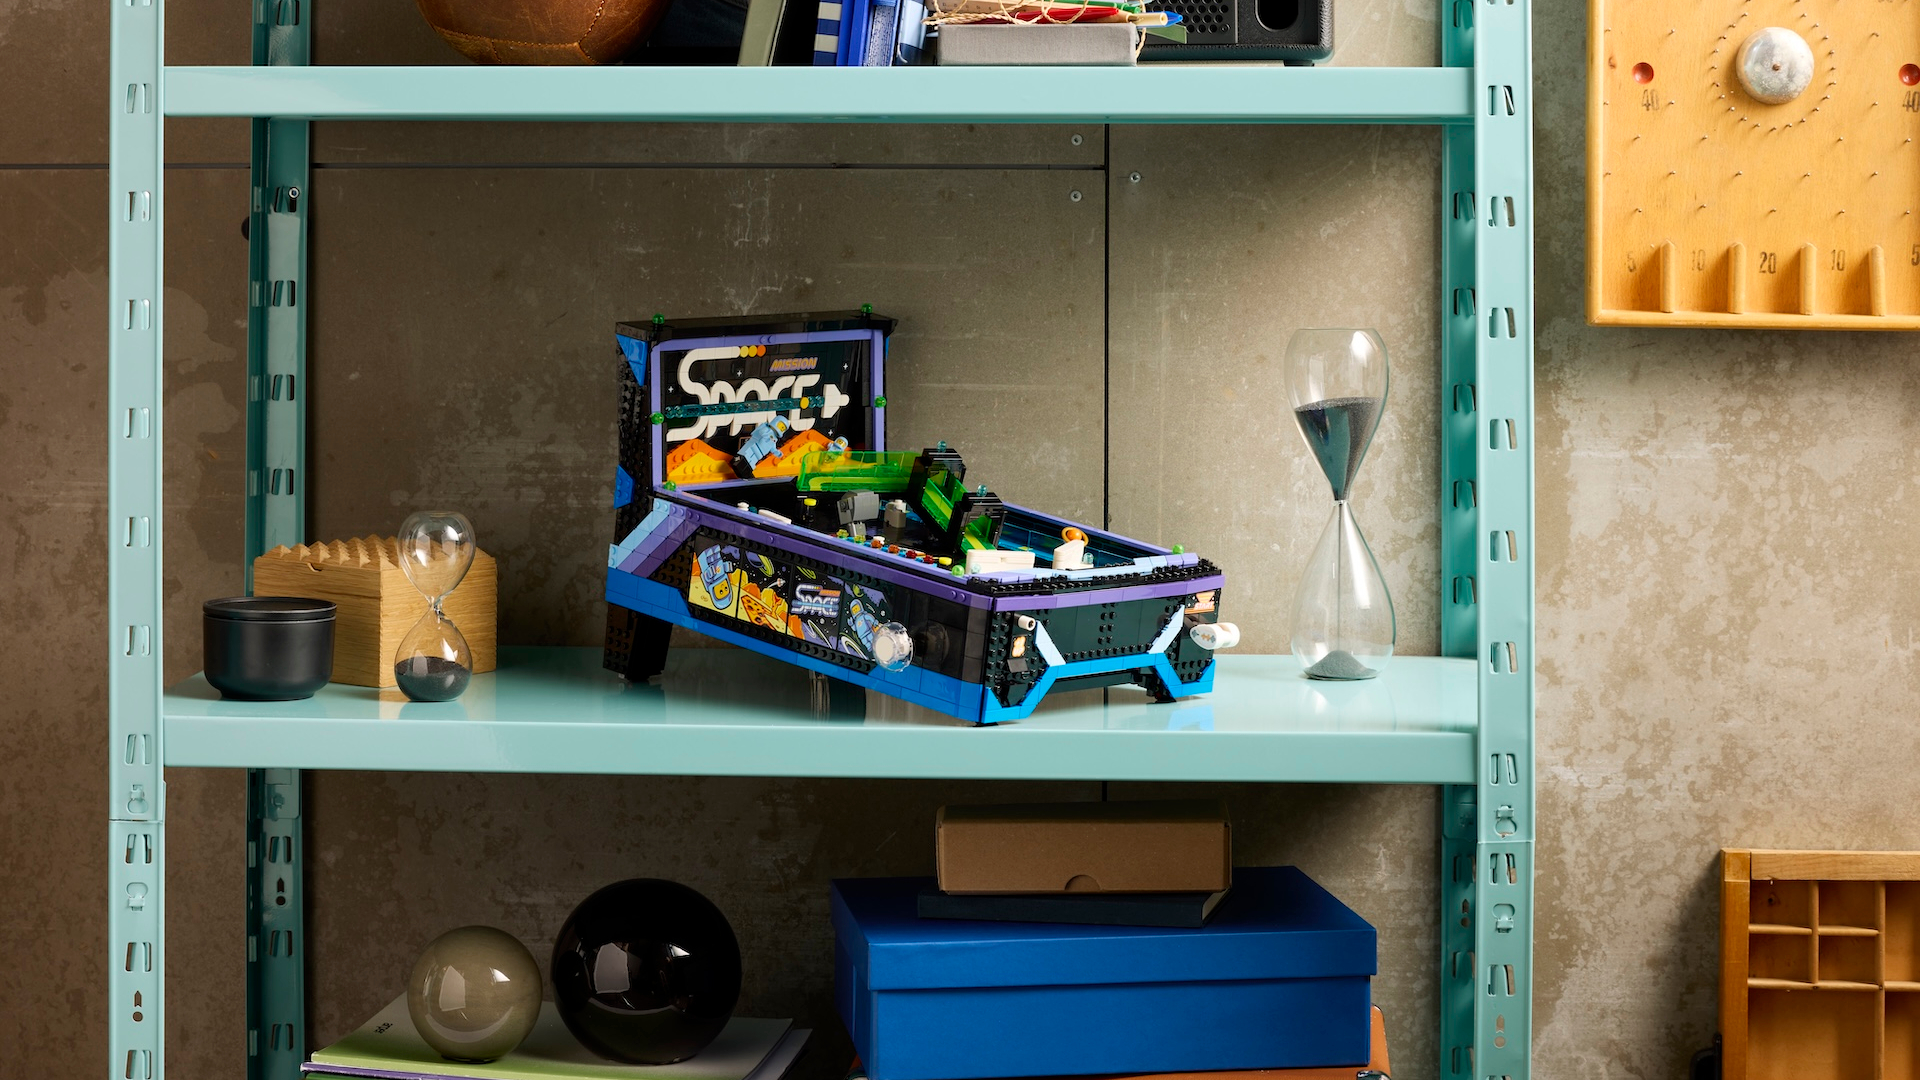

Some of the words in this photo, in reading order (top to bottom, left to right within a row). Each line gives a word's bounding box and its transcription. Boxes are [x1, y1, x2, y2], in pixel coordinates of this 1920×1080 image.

[1640, 88, 1660, 111] 40
[1902, 90, 1920, 113] 40
[1692, 248, 1706, 271] 10
[1759, 251, 1776, 274] 20
[1831, 249, 1846, 271] 10
[769, 356, 818, 372] MISSION
[790, 583, 840, 618] SPACE
